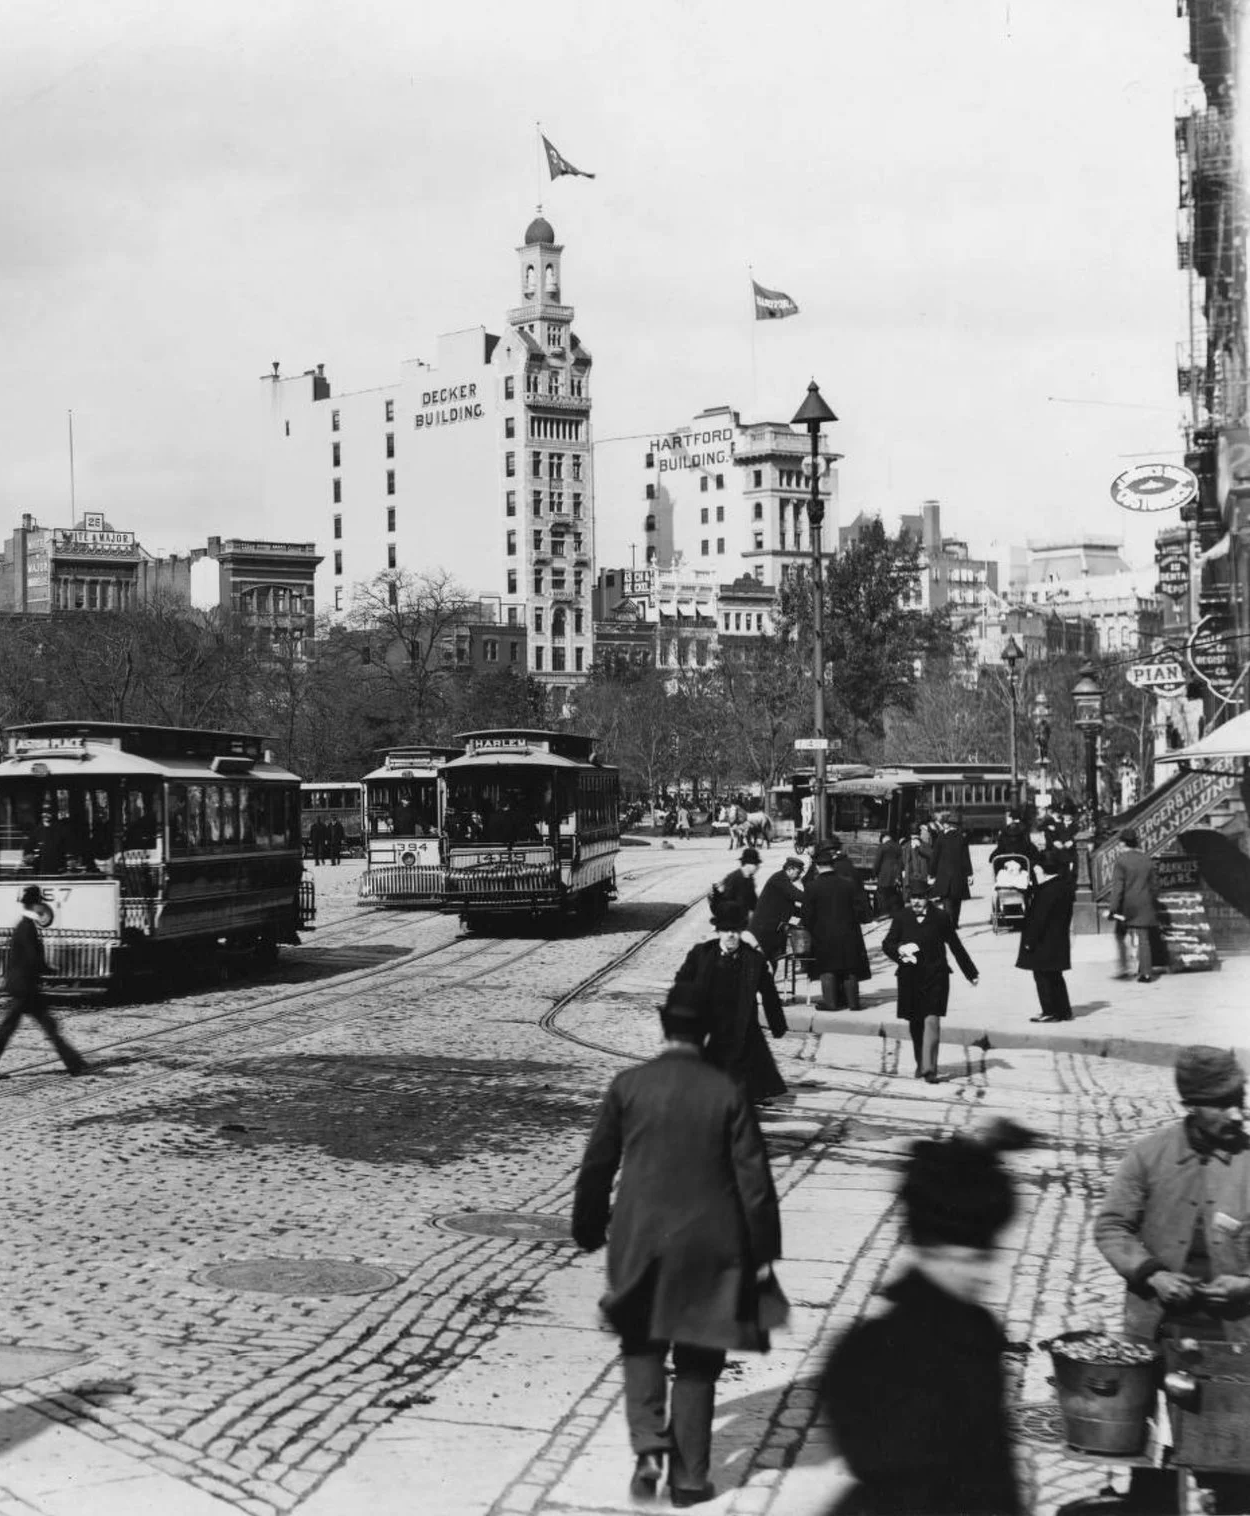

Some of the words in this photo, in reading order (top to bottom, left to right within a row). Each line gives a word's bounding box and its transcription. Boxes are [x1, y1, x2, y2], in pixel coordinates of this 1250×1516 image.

[422, 383, 477, 405] DECKER
[650, 428, 733, 452] HARTFORD
[659, 450, 729, 472] BUILDING.
[99, 533, 129, 543] MAJOR
[475, 738, 527, 748] HARLEM
[393, 843, 428, 851] 1394
